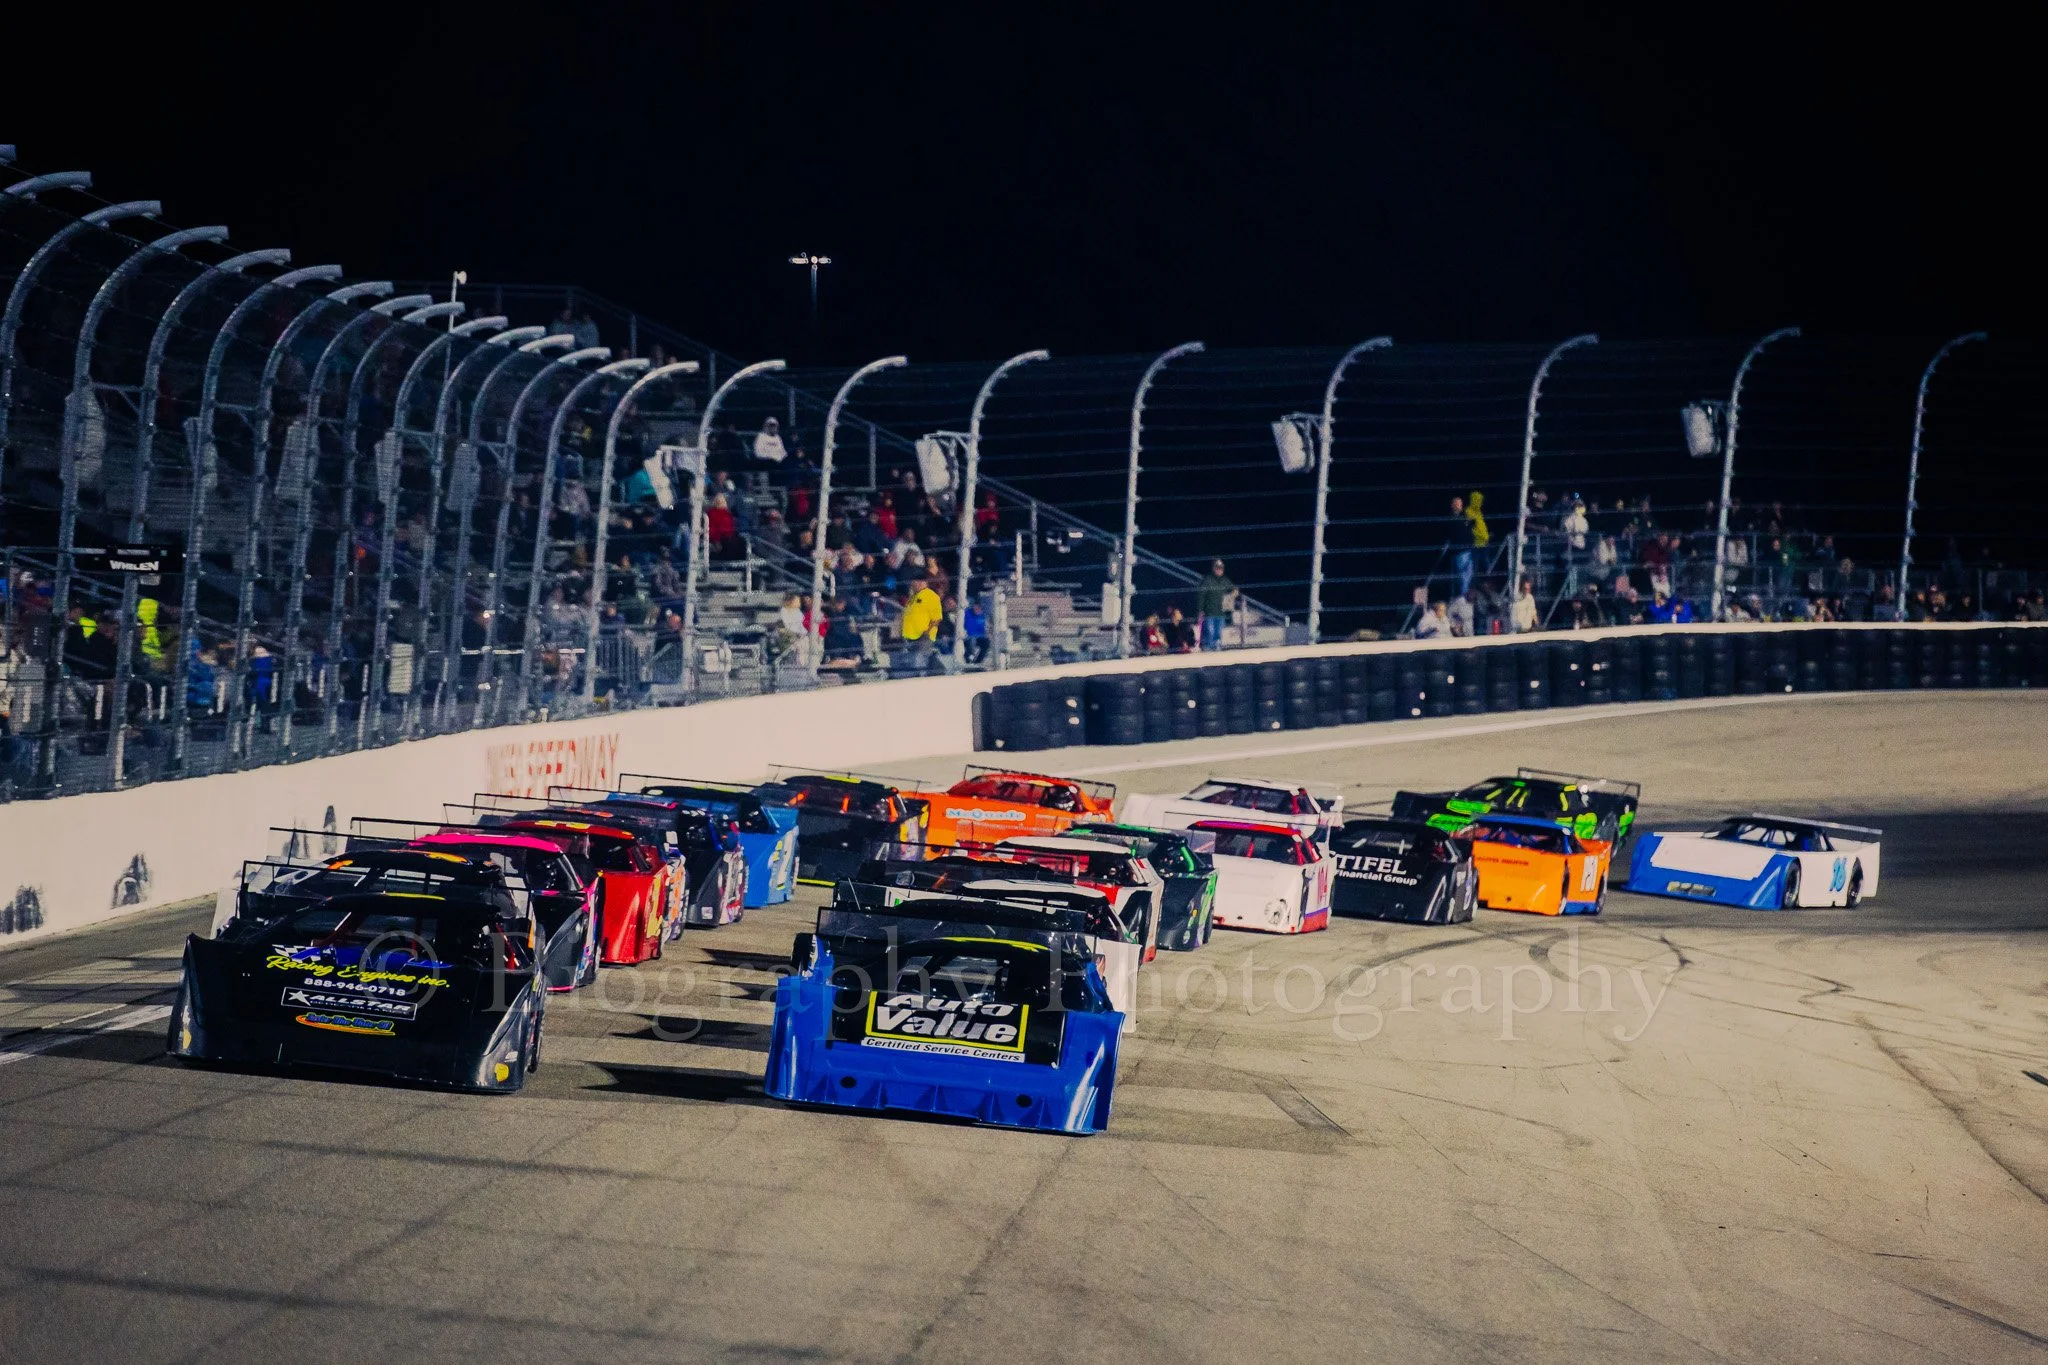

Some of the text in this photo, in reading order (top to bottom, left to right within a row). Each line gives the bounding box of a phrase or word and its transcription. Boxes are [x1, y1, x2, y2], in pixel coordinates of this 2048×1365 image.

[1383, 874, 1418, 886] Group
[266, 956, 334, 976] Racing
[337, 965, 416, 983] Engines
[304, 977, 406, 997] 888-946-0718
[309, 994, 411, 1012] ALLSTAR
[884, 994, 1015, 1017] Auto
[877, 1005, 1018, 1043] Value
[866, 1038, 1021, 1062] Certified Service Centers
